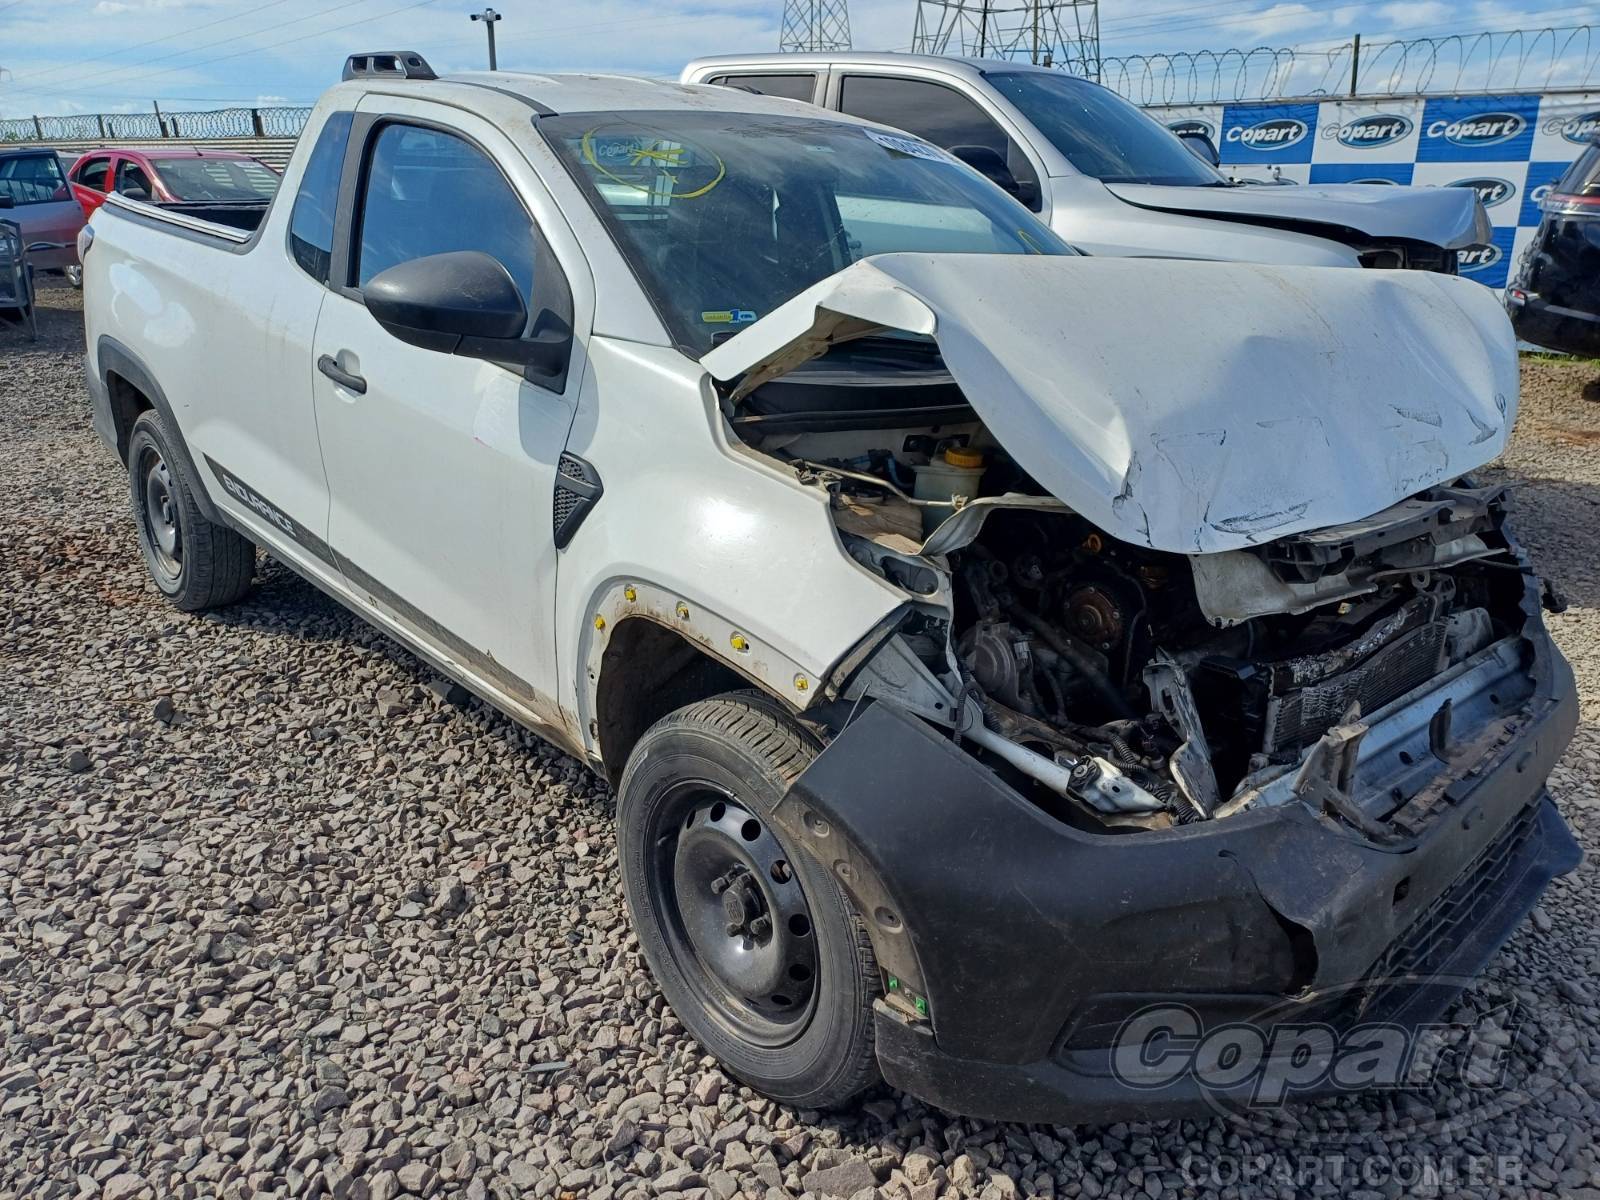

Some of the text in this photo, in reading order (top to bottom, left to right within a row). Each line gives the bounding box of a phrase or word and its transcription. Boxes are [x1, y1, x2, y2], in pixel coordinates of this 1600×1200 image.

[1226, 124, 1298, 144] Copart
[1321, 121, 1402, 142] Copart
[1427, 118, 1516, 140] Copart
[1542, 117, 1600, 138] Cop
